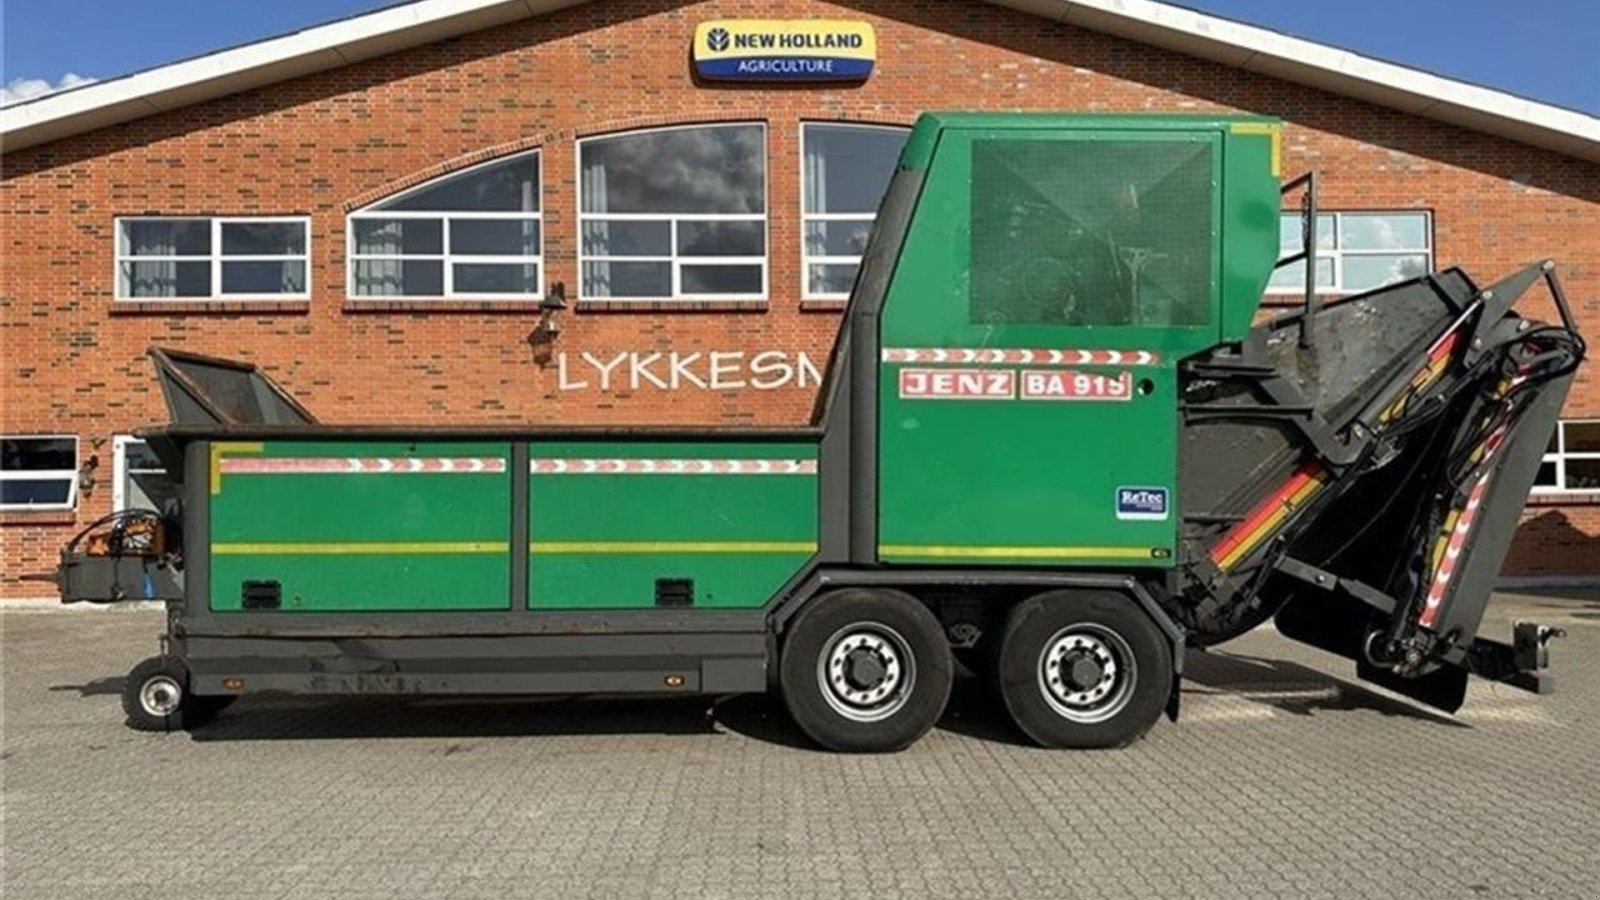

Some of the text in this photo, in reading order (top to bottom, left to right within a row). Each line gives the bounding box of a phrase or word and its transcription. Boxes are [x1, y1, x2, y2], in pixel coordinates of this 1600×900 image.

[734, 33, 863, 48] NEW HOLLAND
[738, 59, 834, 73] AGRICULTURE
[905, 373, 1126, 396] JENZ BA 915
